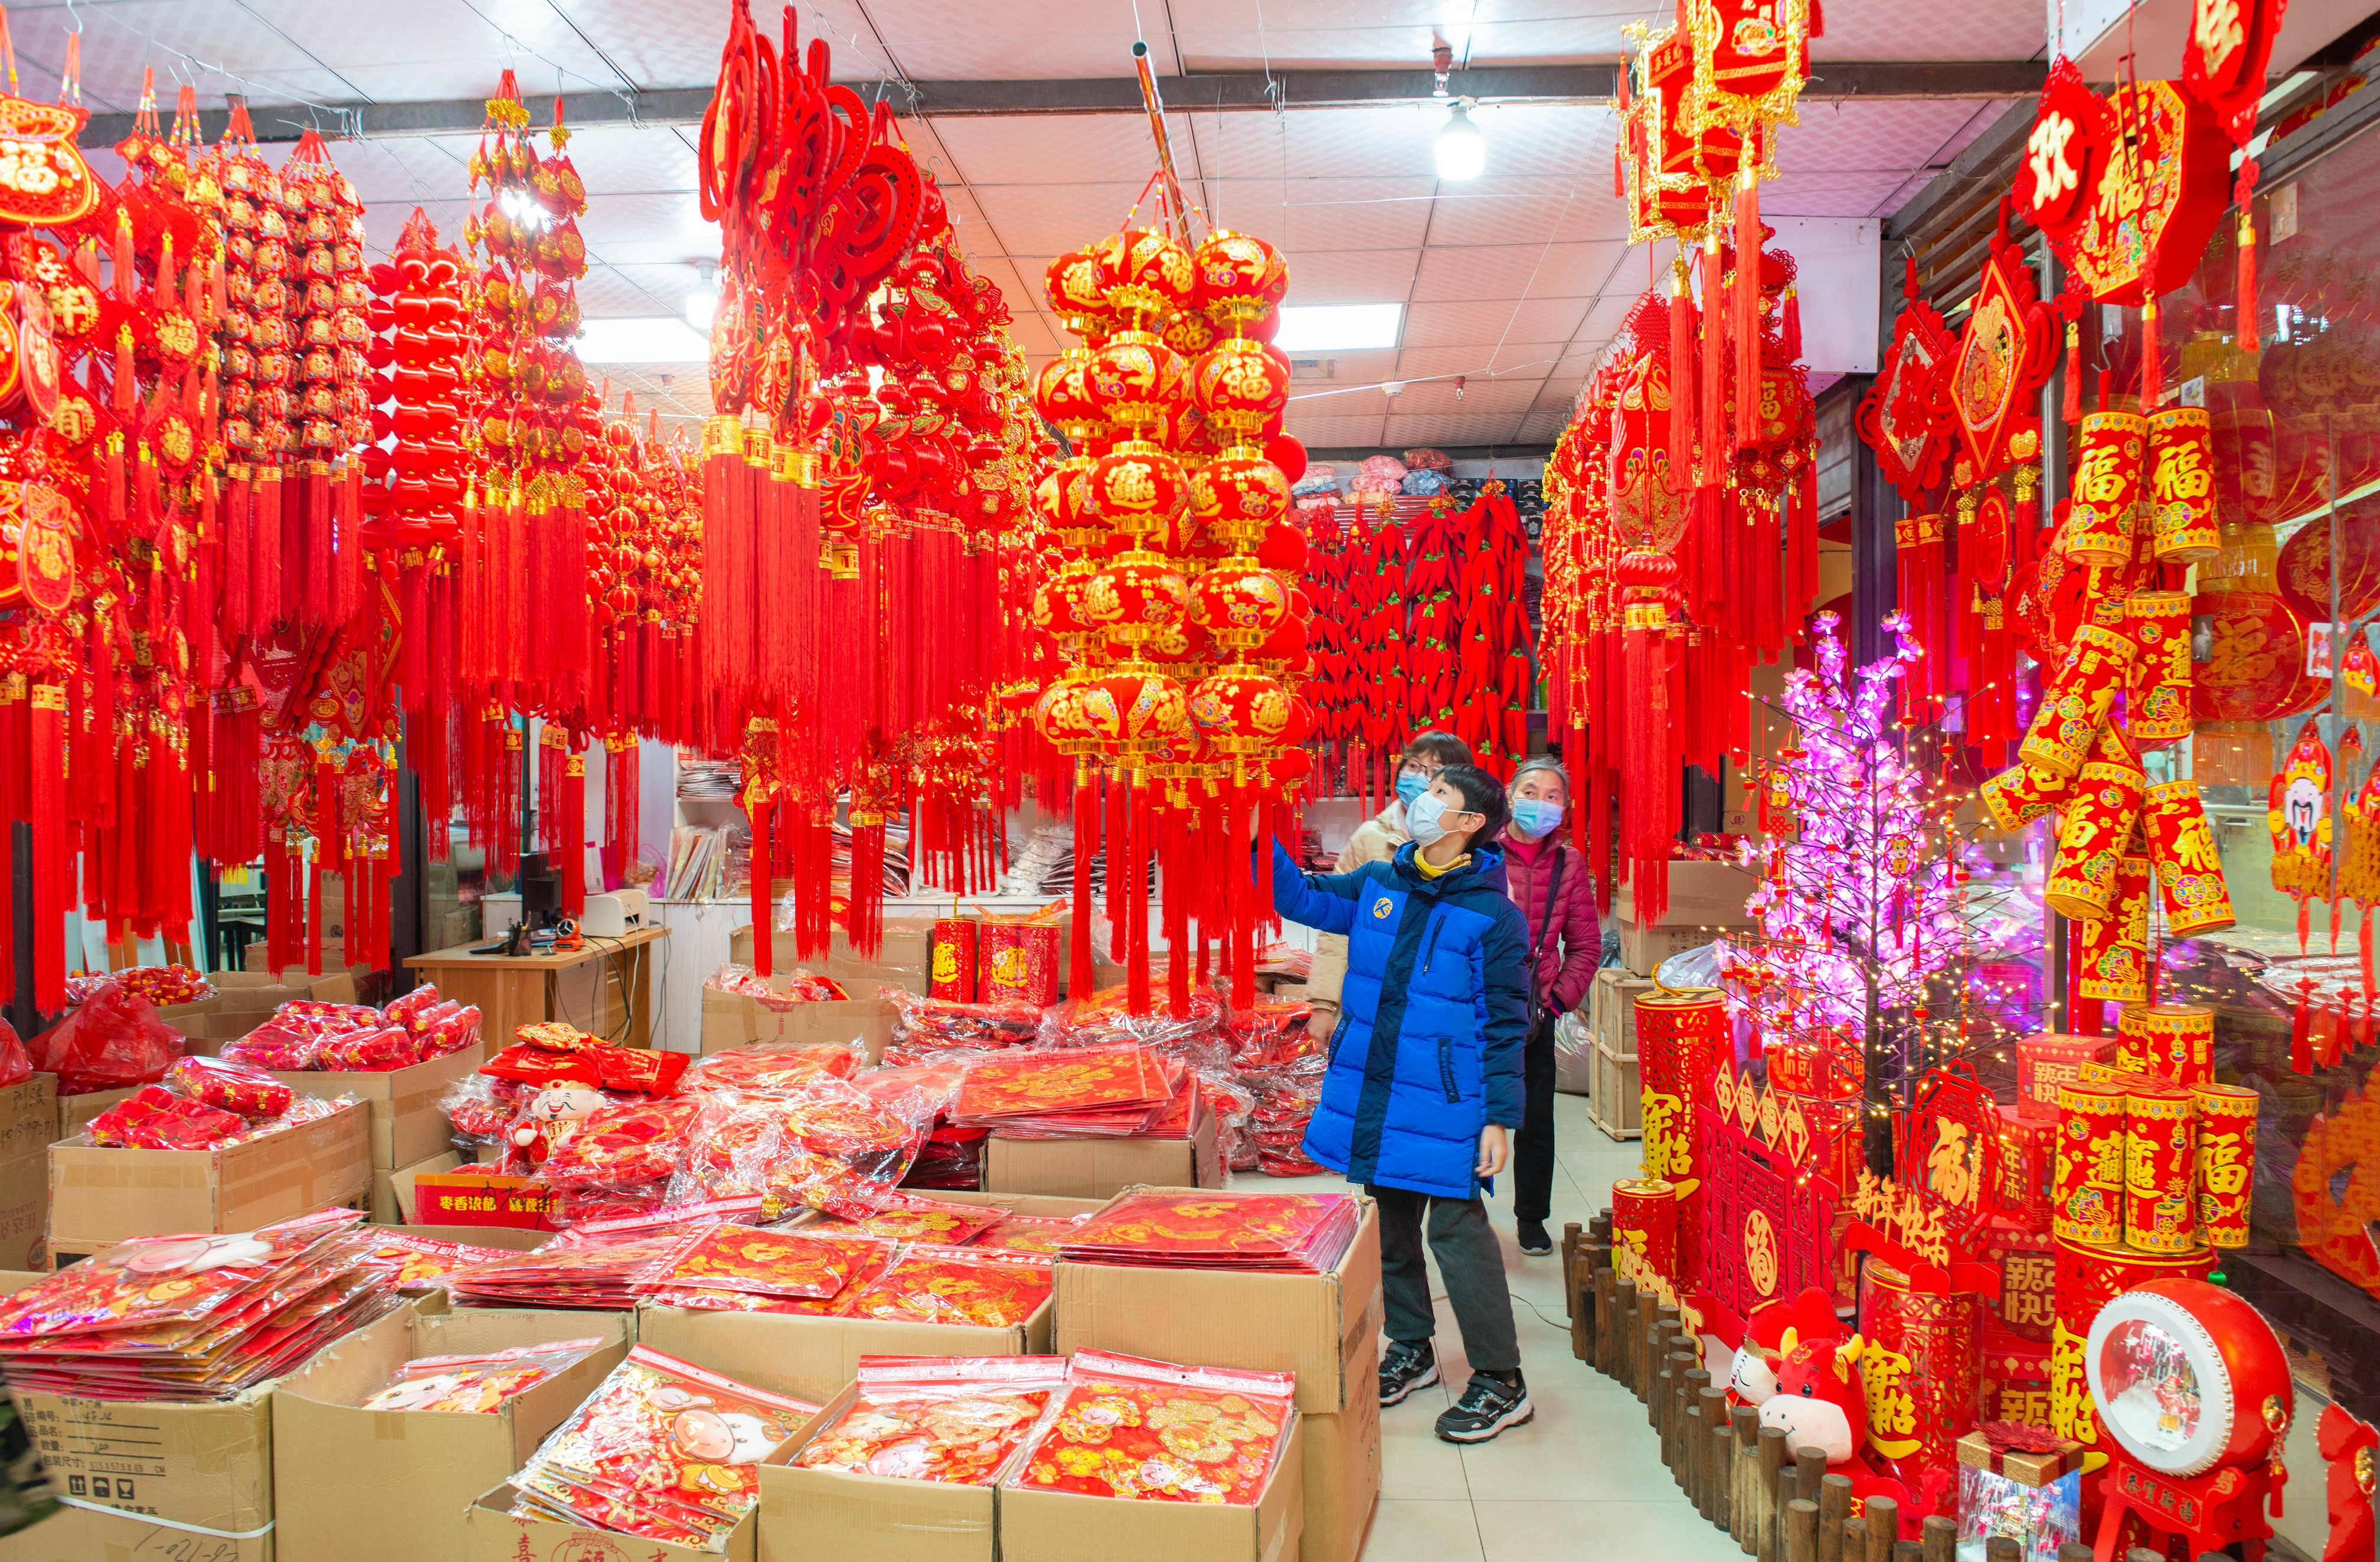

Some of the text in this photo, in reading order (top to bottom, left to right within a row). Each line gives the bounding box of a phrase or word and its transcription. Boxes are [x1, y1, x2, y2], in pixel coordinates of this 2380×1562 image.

[1222, 355, 1272, 401] 福
[2072, 445, 2127, 502] 福
[2153, 440, 2211, 501] 福
[2034, 1062, 2078, 1083] 新年
[2034, 1083, 2060, 1103] 快
[1928, 1116, 1970, 1206] 福
[1851, 1165, 1950, 1269] 新年快乐
[1746, 1213, 1776, 1294] 福
